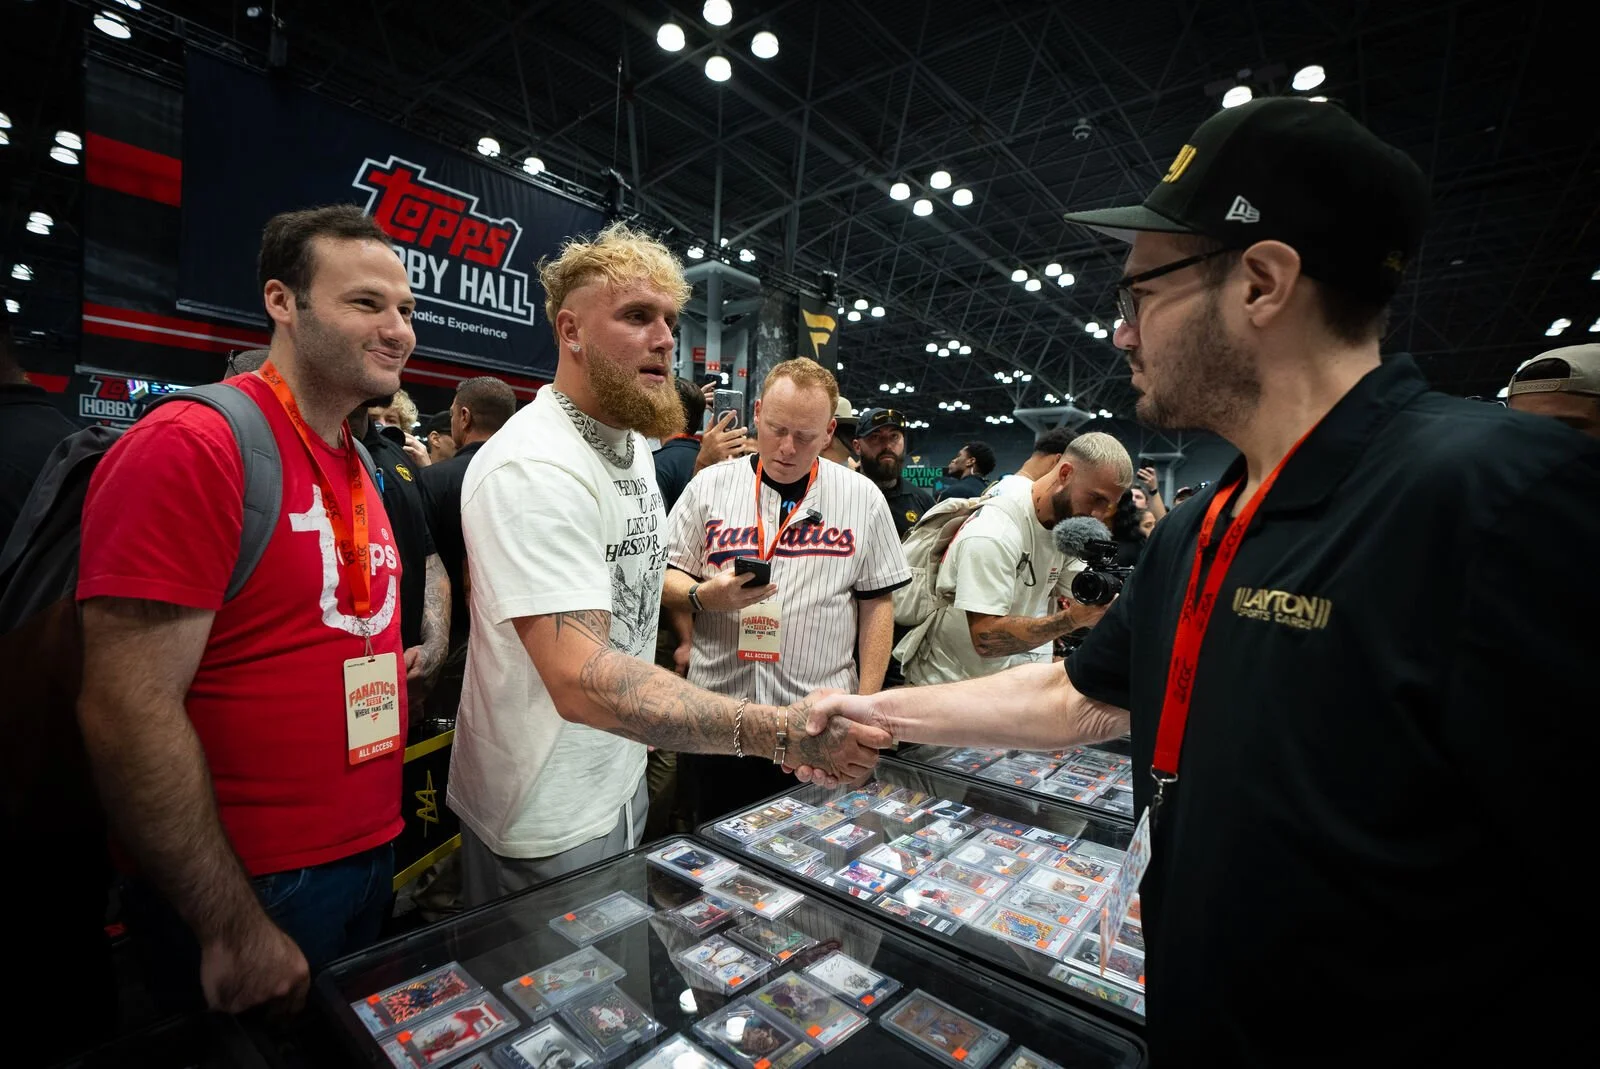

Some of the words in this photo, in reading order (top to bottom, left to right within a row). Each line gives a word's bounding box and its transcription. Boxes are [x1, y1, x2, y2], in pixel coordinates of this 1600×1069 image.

[459, 264, 527, 316] HALL
[410, 309, 446, 325] natics
[448, 317, 508, 340] Experience
[84, 398, 138, 418] HOBBY
[902, 467, 943, 478] BUYING
[1242, 588, 1318, 620] LAYTON
[742, 616, 779, 629] FANATICS
[349, 681, 396, 708] FANATICS
[355, 708, 370, 719] WHERE
[359, 747, 370, 757] ALL
[372, 740, 393, 753] ACCESS
